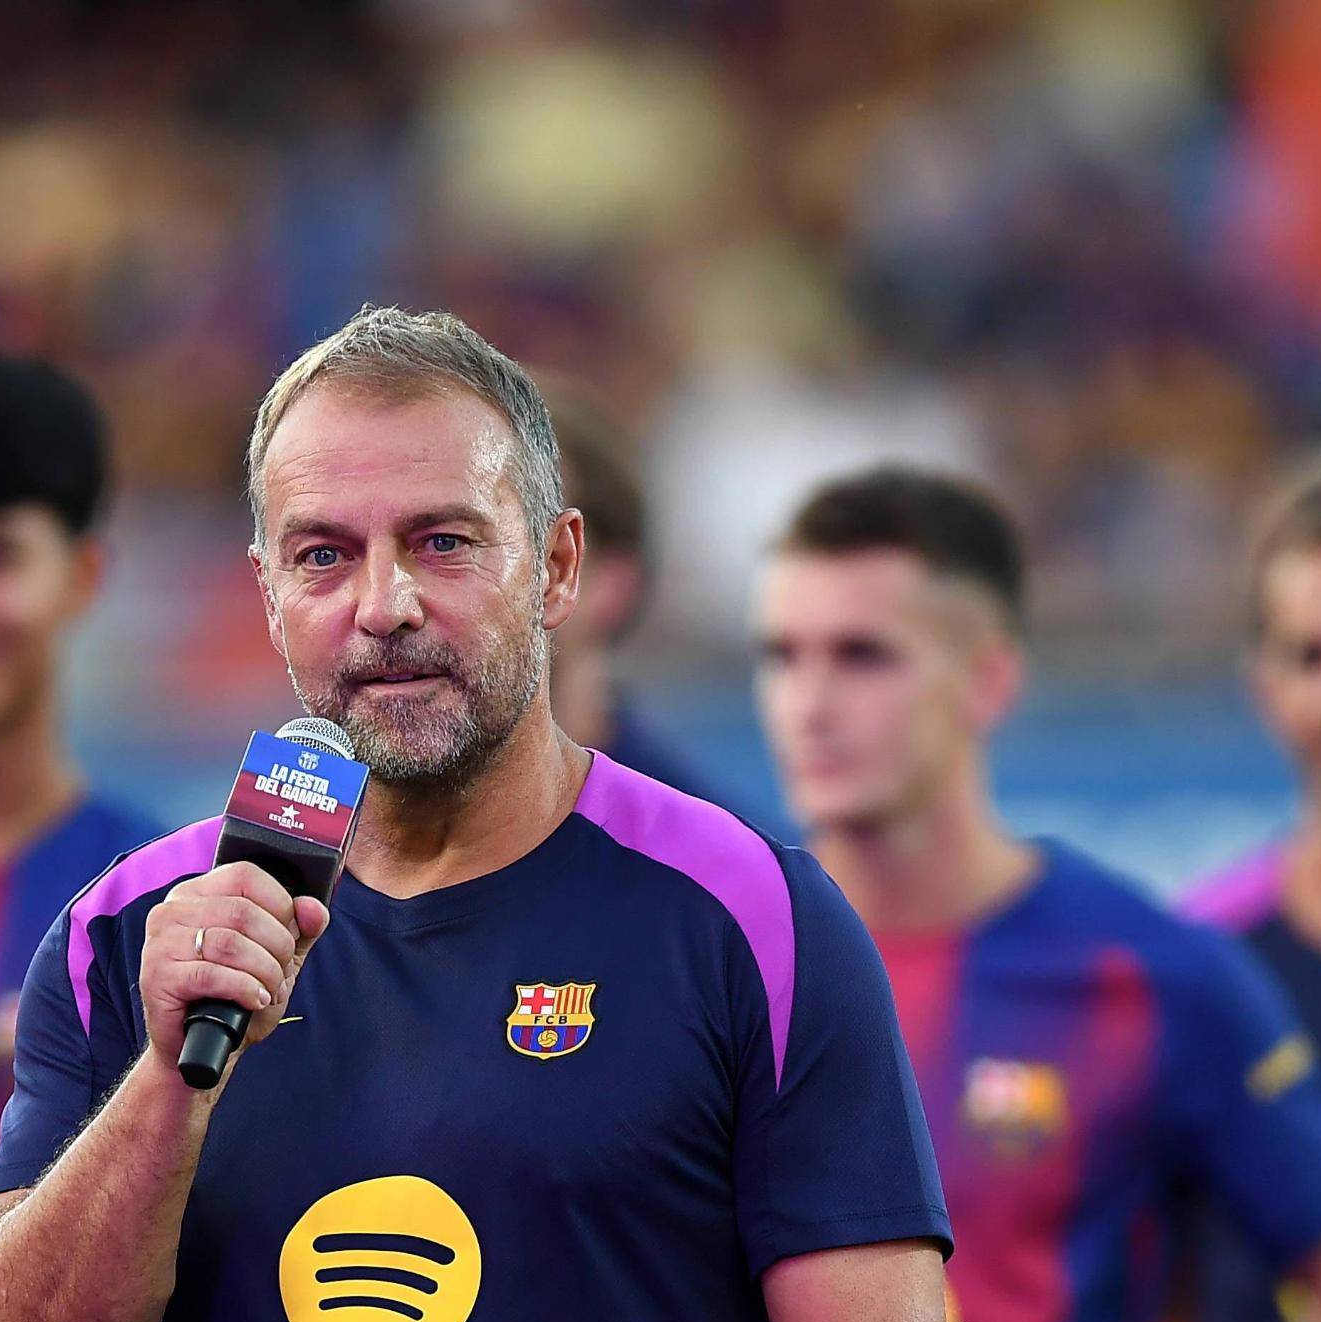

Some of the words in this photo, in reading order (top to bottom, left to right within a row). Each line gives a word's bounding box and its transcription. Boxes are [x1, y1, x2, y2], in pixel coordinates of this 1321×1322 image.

[254, 775, 279, 796] DEL
[279, 782, 338, 814] GAMPER
[270, 763, 287, 782] LA
[288, 768, 330, 795] FESTA
[268, 813, 305, 830] ESTRELLA
